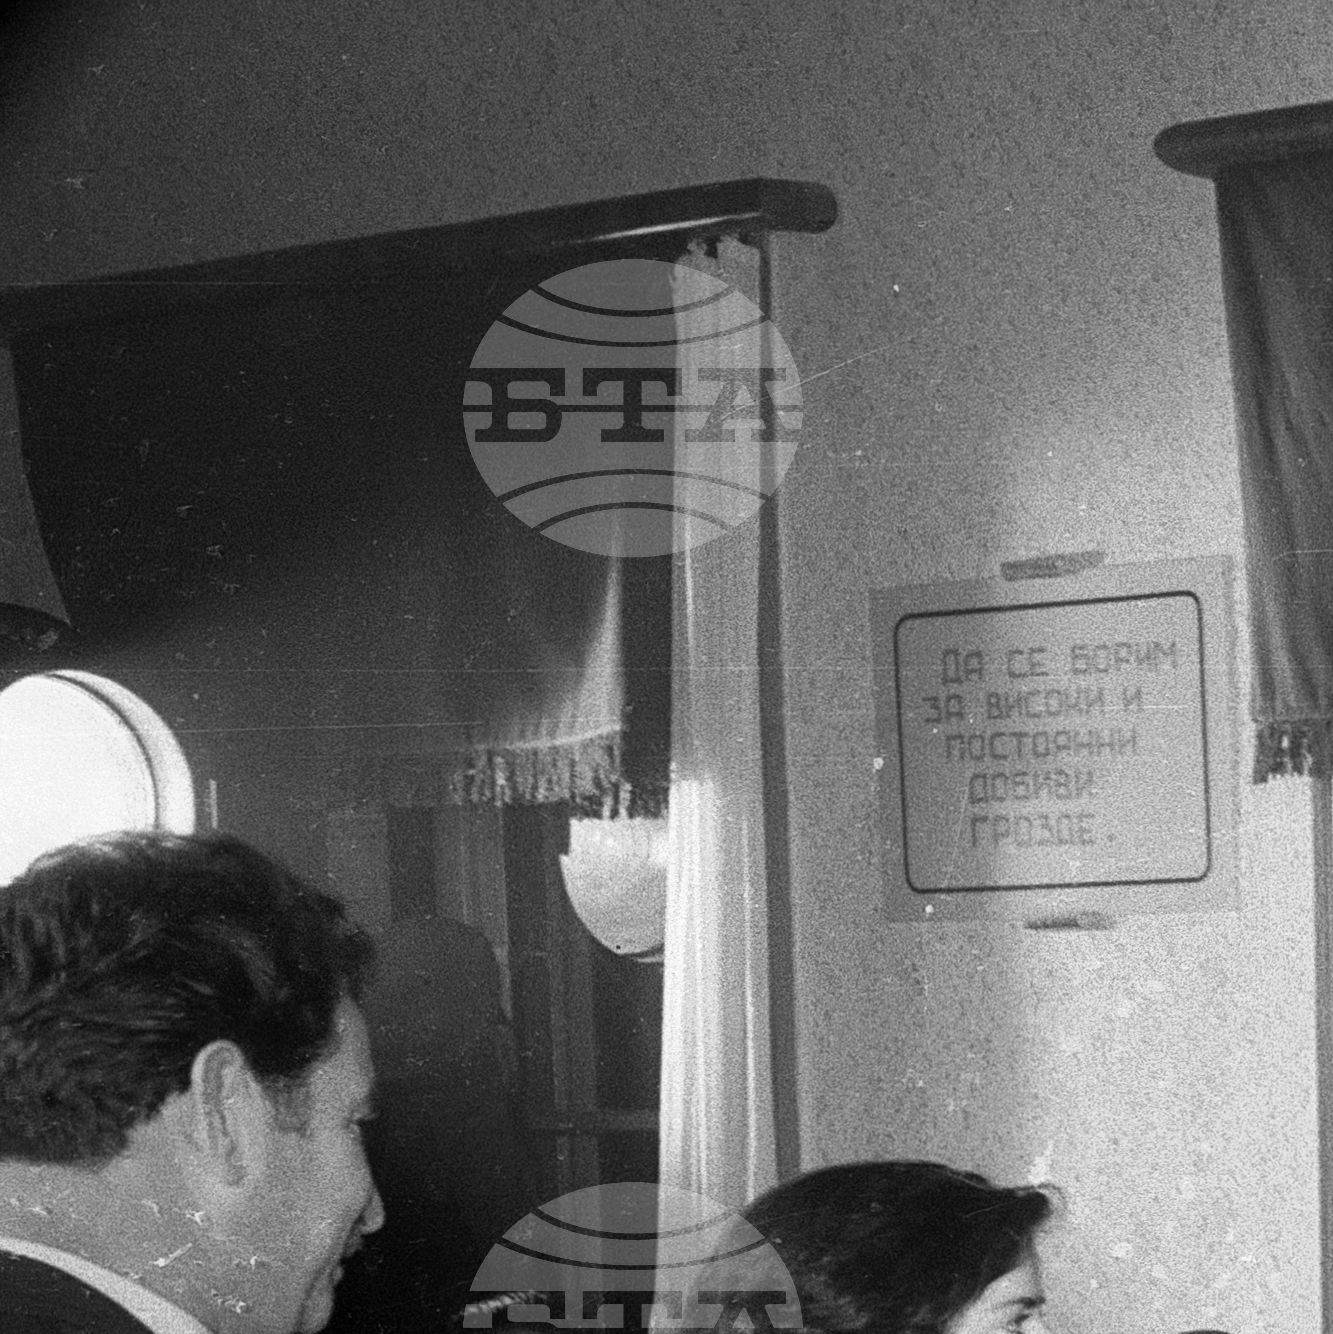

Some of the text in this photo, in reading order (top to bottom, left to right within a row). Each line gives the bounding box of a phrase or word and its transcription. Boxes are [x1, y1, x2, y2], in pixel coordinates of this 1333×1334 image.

[941, 641, 1177, 685] ДА СЕ БОРИМ
[922, 687, 1142, 724] ЗА ВИСОКИ И
[945, 730, 1138, 762] ПОСТОЯННИ
[969, 769, 1095, 804] ДОБИВИ
